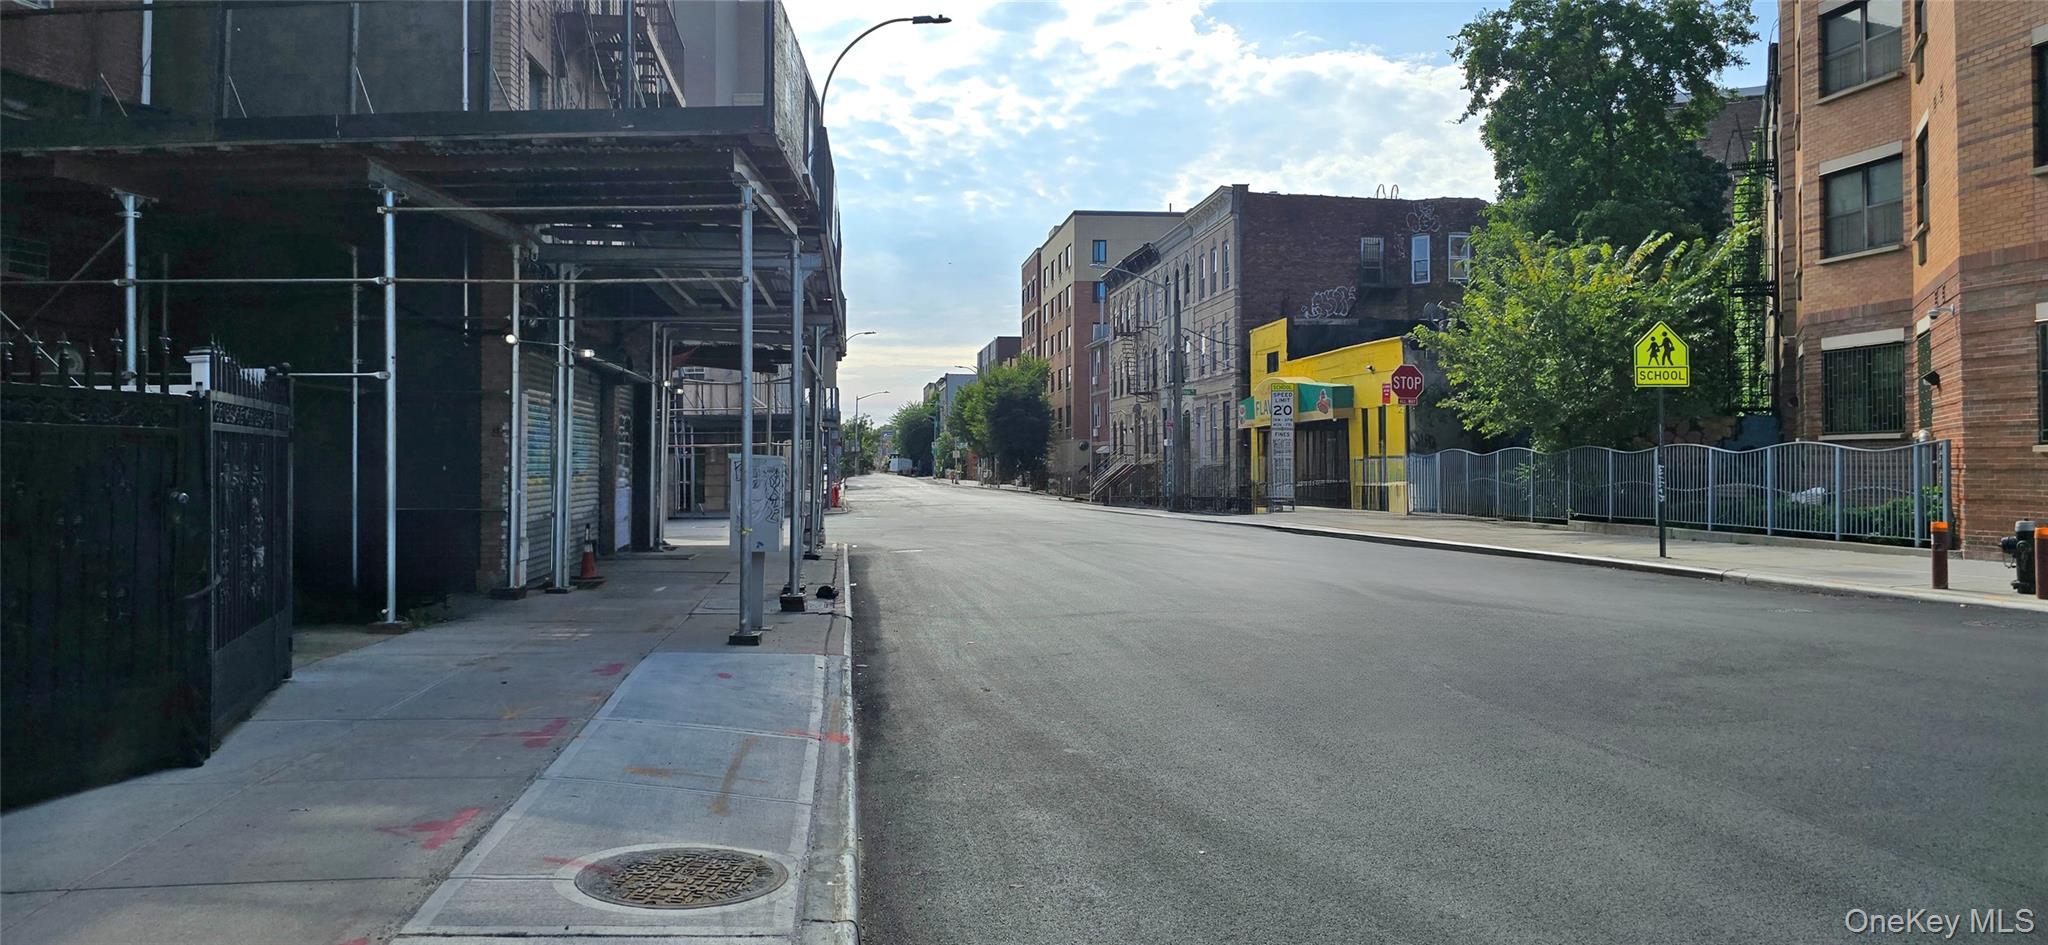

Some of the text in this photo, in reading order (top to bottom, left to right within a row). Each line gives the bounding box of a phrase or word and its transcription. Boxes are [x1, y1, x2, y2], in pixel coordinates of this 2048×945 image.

[1639, 370, 1685, 380] SCHOOL
[1393, 376, 1421, 390] STOP
[1273, 405, 1292, 416] 20
